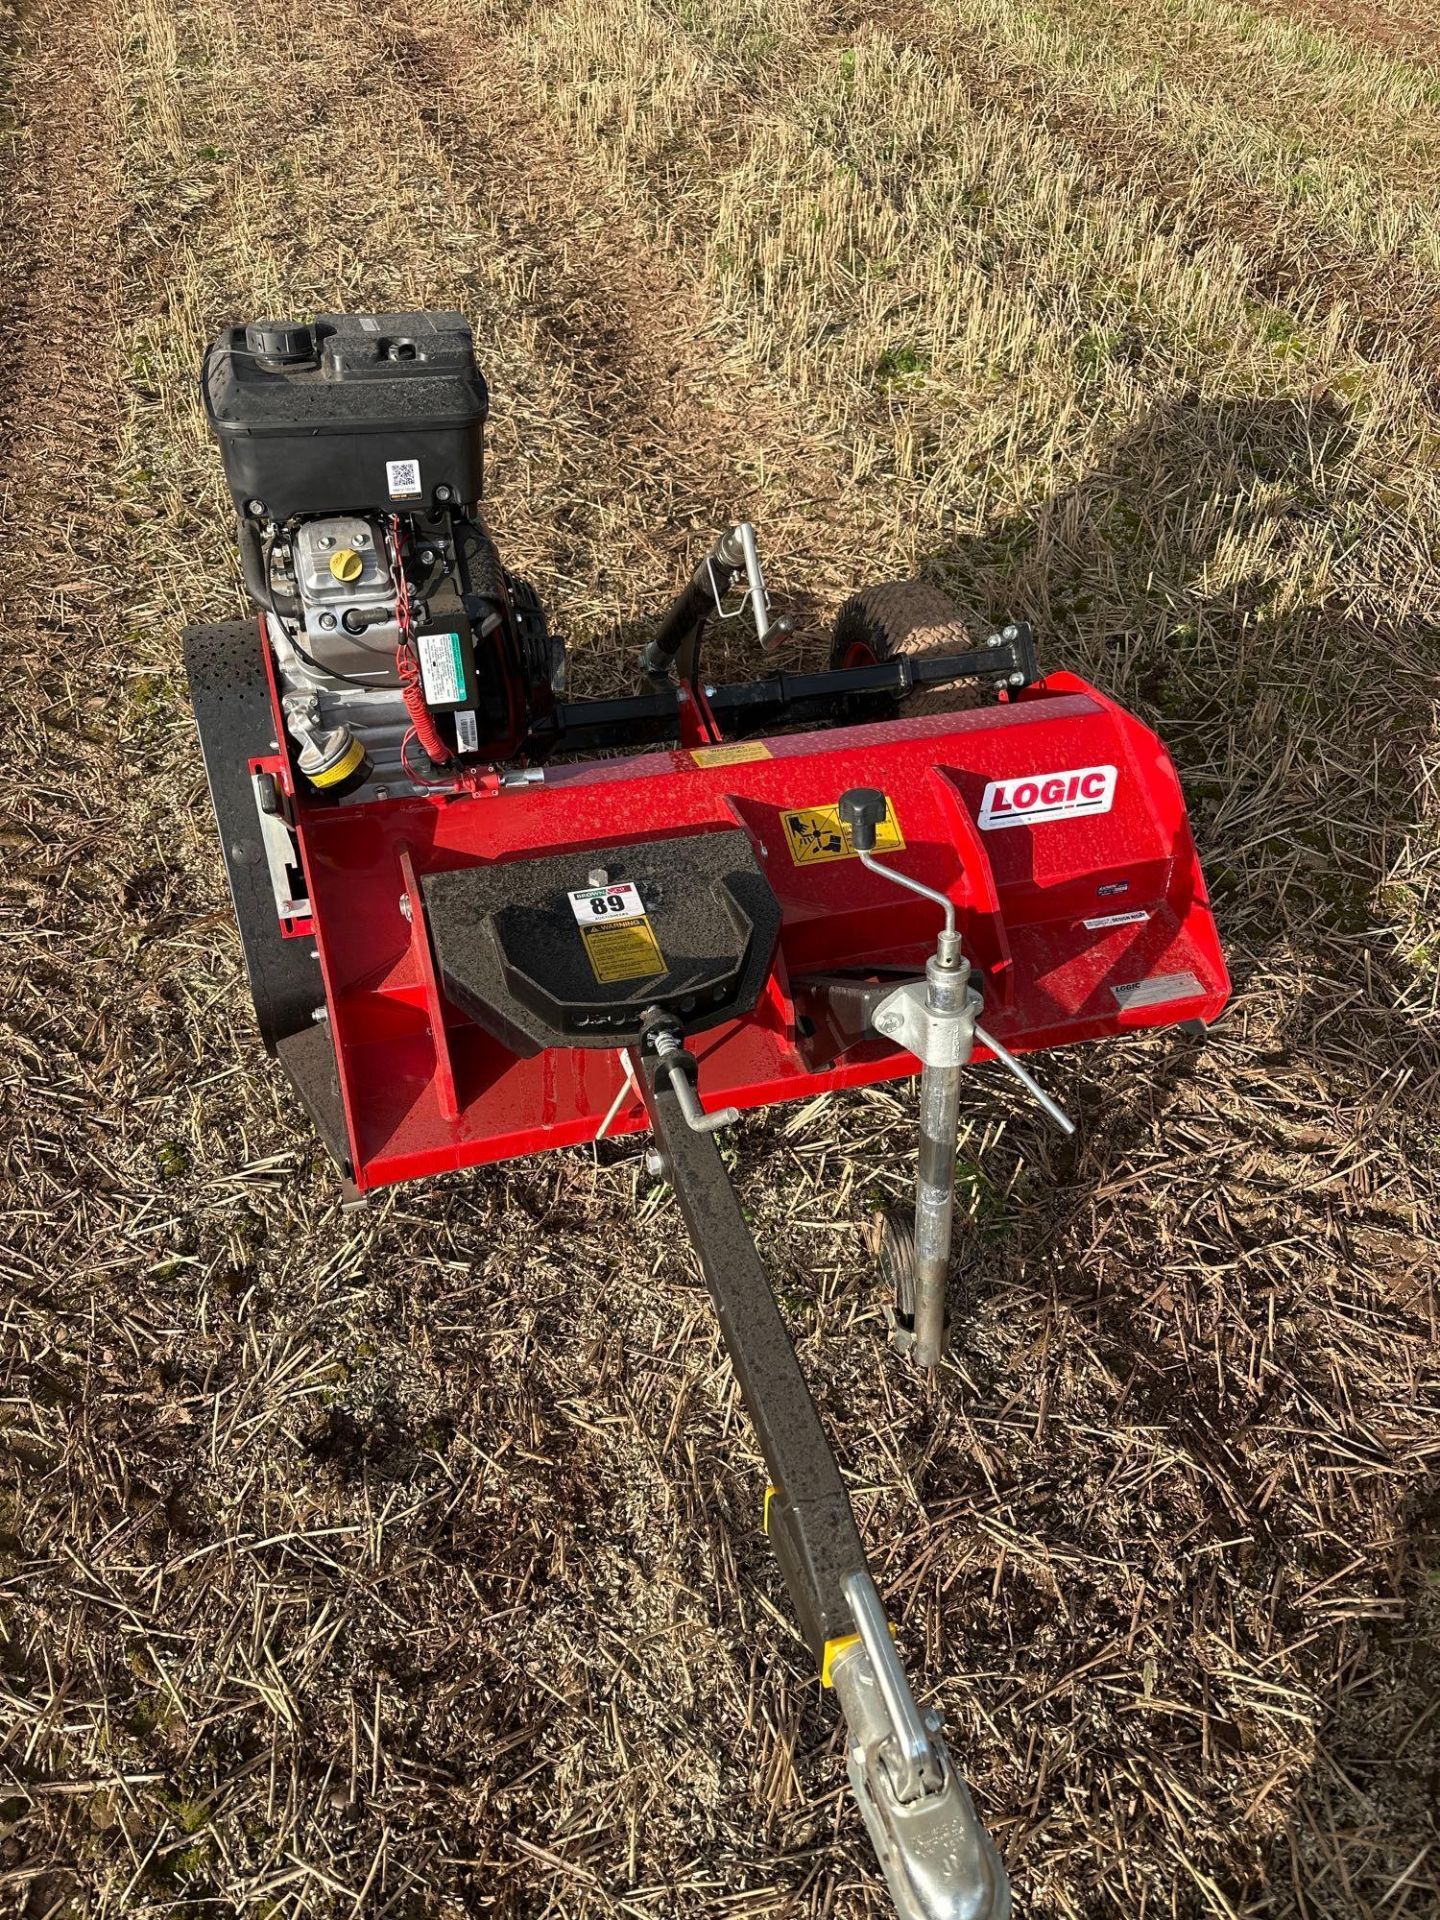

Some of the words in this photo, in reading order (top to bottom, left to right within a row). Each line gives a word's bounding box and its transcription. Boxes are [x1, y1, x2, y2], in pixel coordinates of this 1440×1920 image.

[991, 773, 1106, 812] LOGIC
[576, 889, 605, 899] BROWN
[589, 895, 625, 914] 89
[600, 920, 640, 931] WARNING
[1115, 983, 1141, 992] LOGIC
